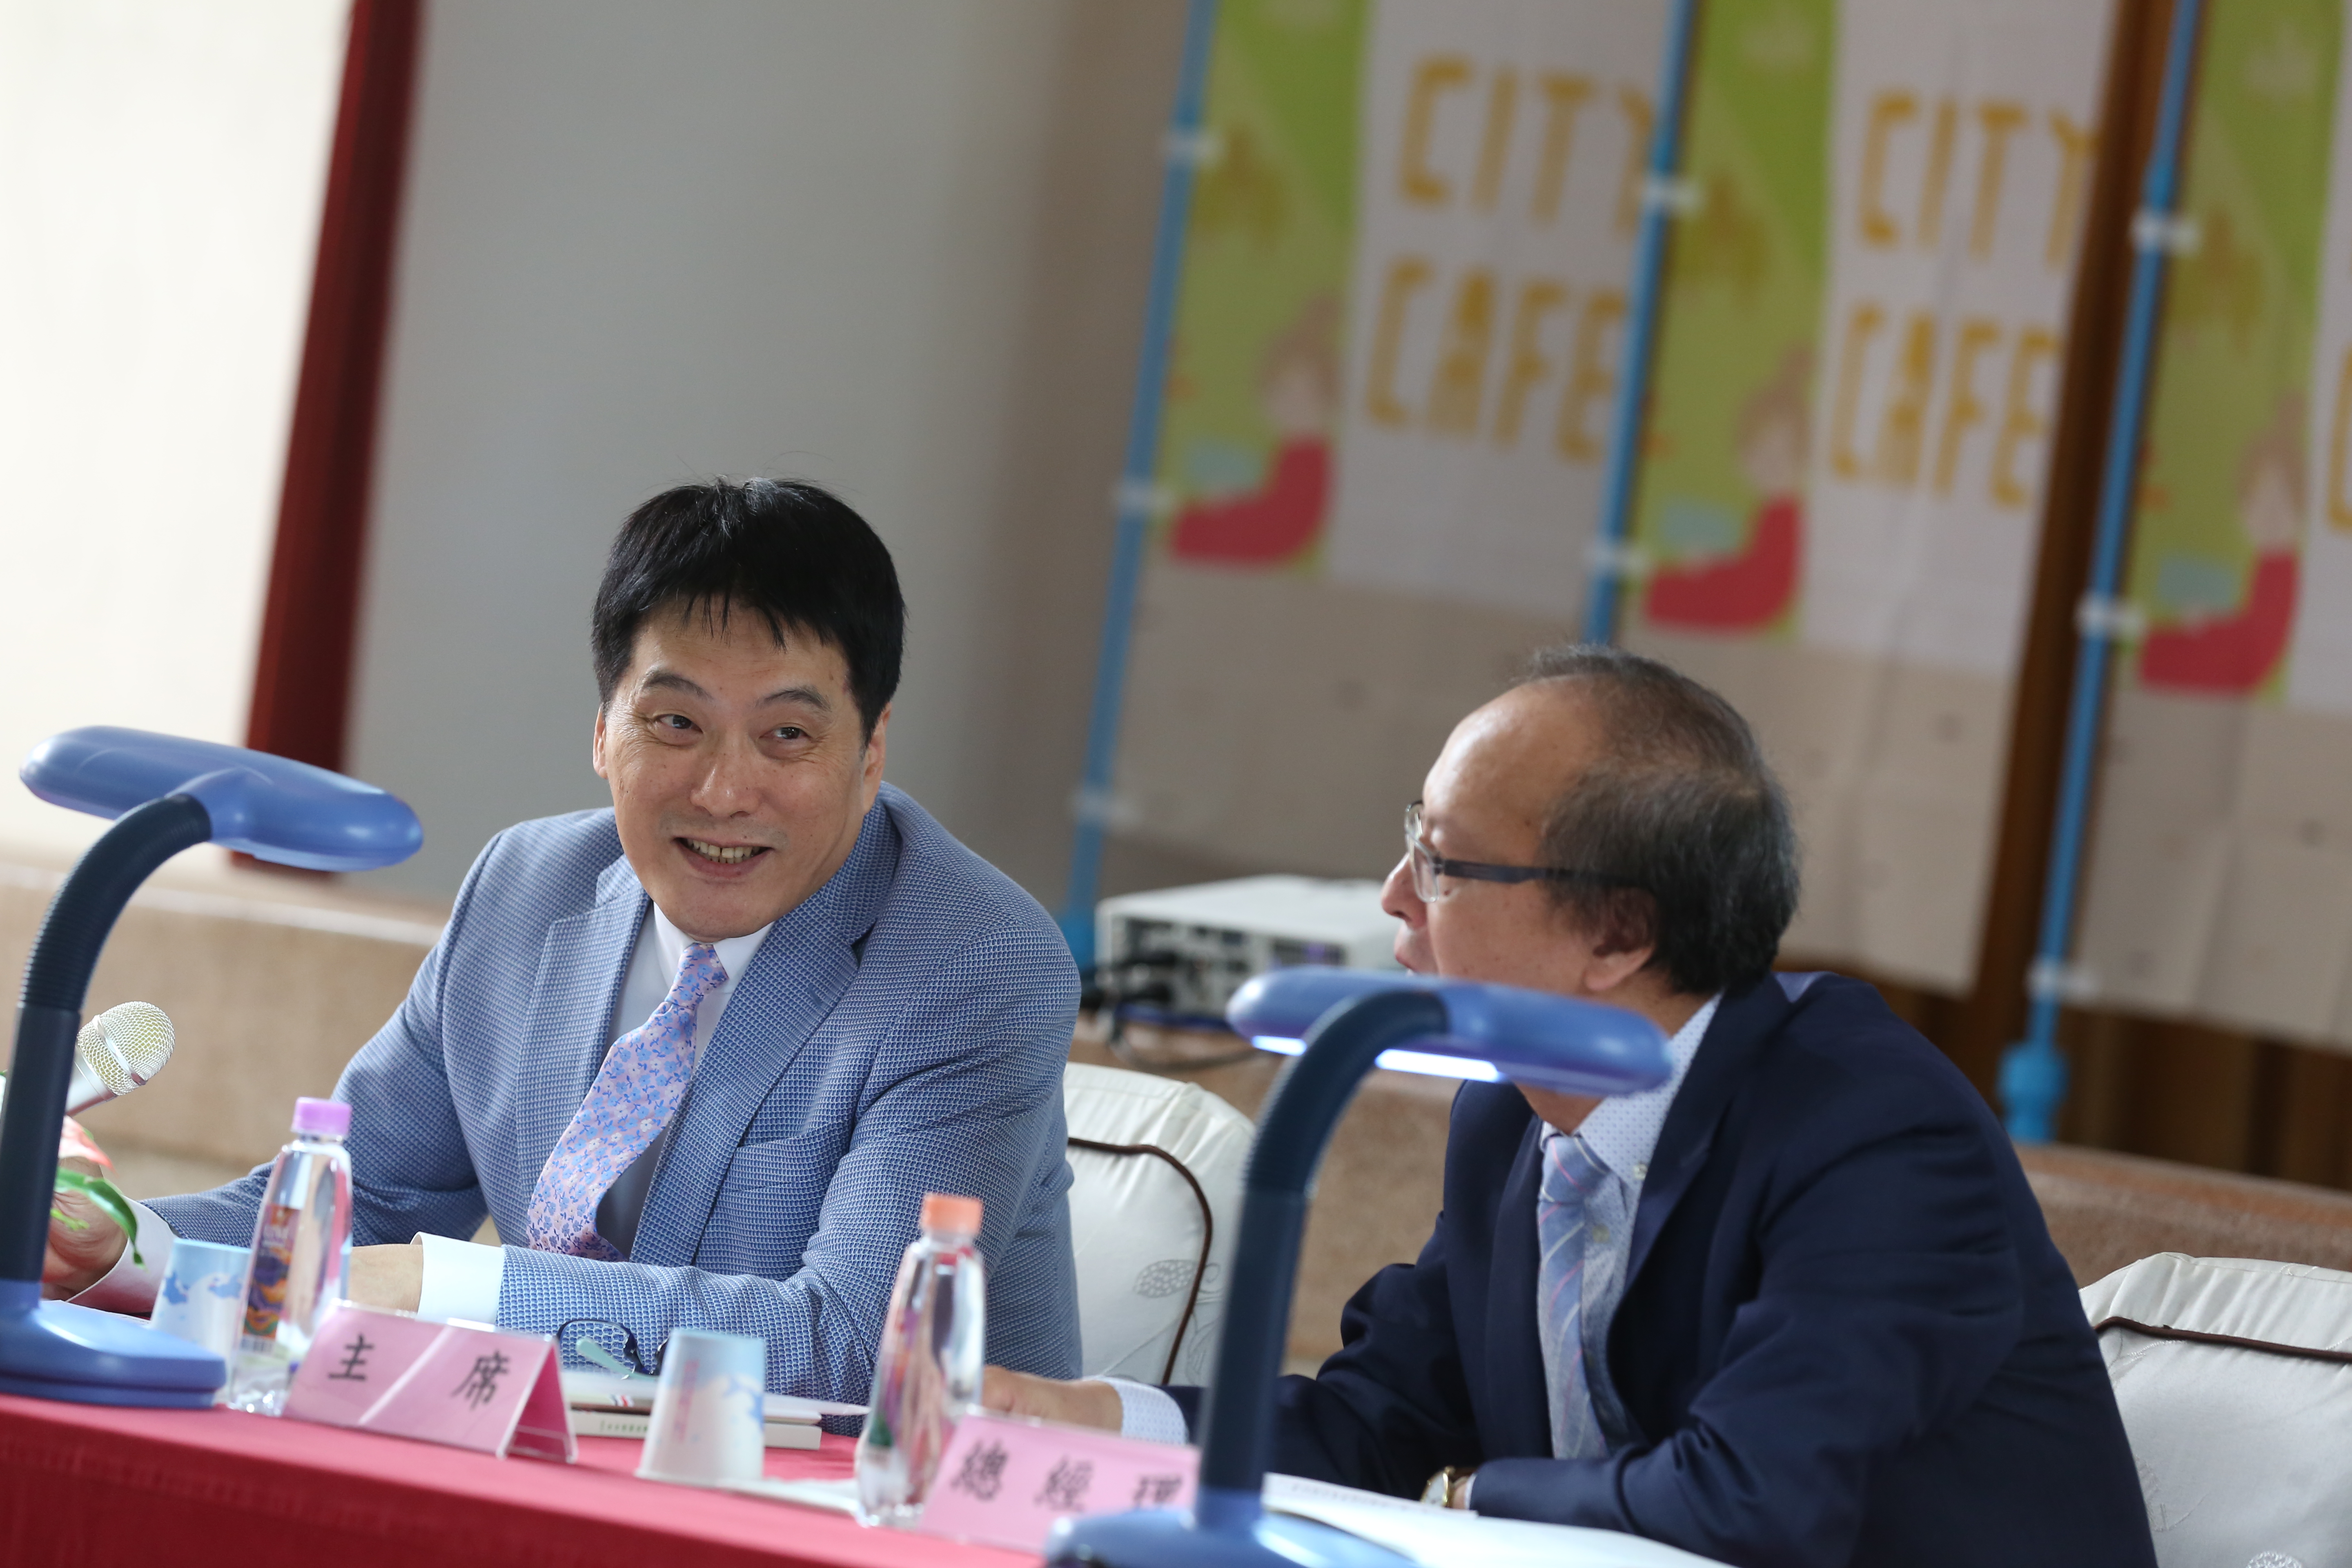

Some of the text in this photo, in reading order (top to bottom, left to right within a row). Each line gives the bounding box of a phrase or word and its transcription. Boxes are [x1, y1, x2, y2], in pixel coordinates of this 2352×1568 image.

[1860, 90, 2103, 273] CITY
[1366, 256, 1626, 466] CAFE
[1831, 300, 2059, 508] CAFE
[328, 1334, 510, 1410] 主席
